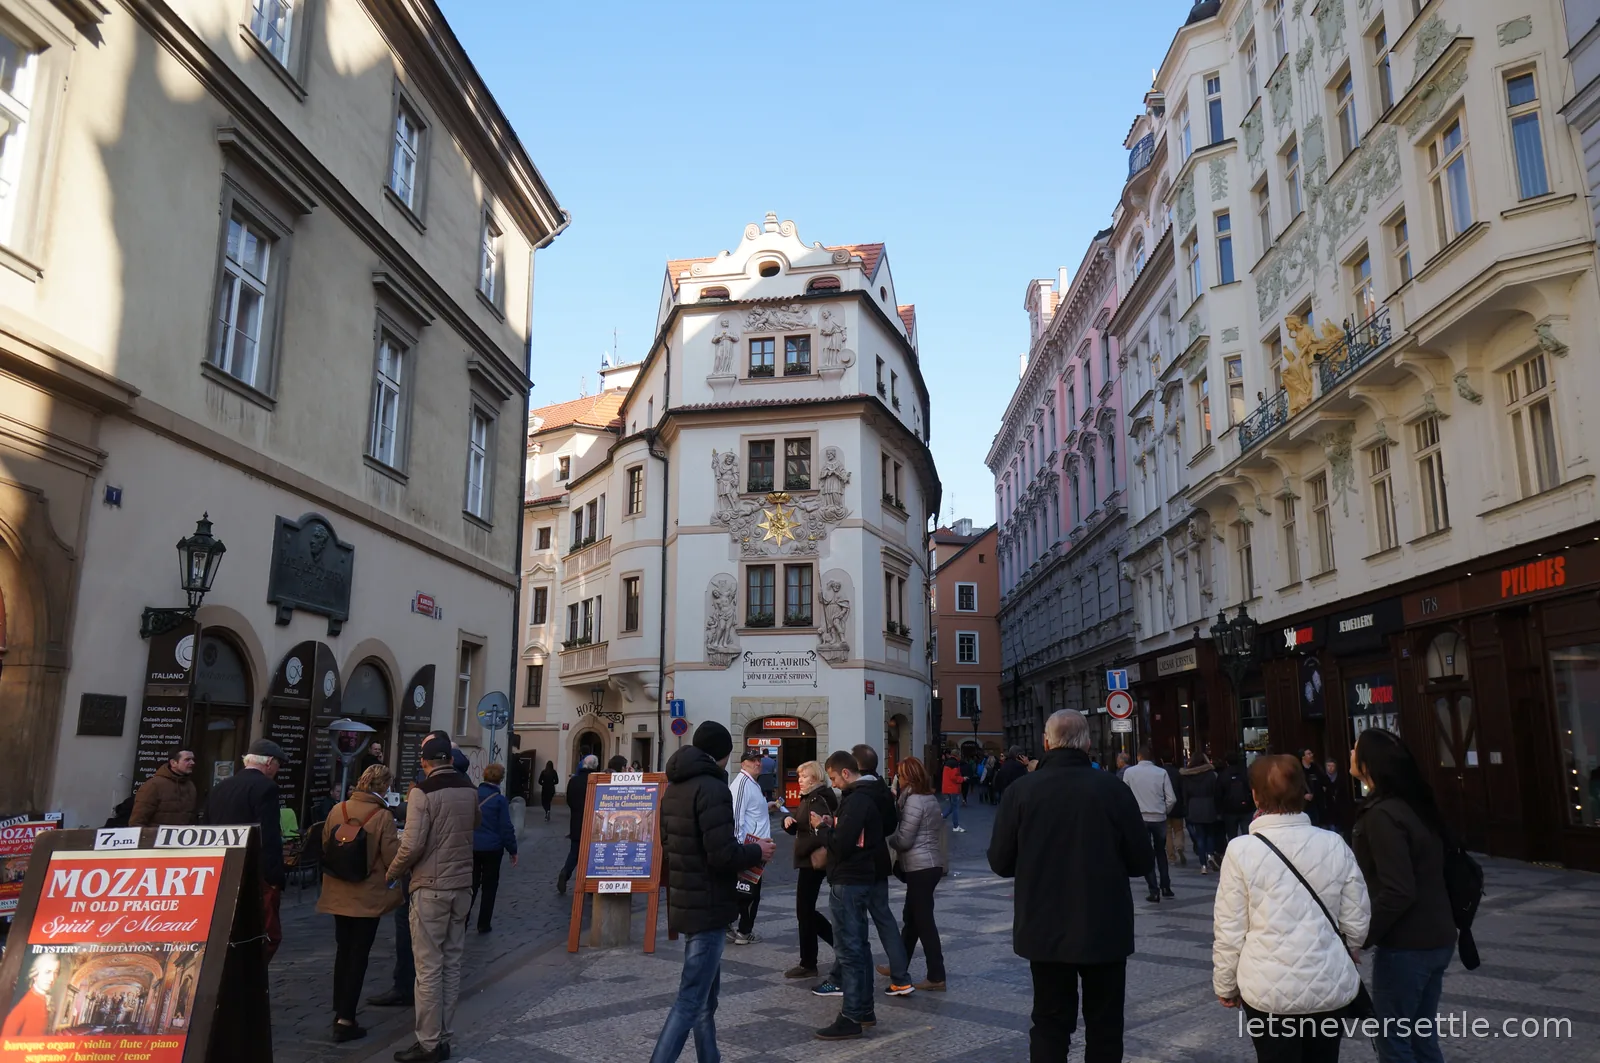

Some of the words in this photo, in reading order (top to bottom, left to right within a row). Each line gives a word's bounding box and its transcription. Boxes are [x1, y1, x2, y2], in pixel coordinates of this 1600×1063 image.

[1501, 556, 1566, 598] PYLONES
[1421, 597, 1438, 615] 178
[1339, 614, 1374, 633] JEWELLERY
[750, 658, 778, 667] HOTEL
[780, 658, 810, 666] AURUS
[151, 672, 184, 680] ITALIANO
[767, 672, 788, 680] ZLATÉ
[0, 815, 27, 827] ODAY
[100, 833, 115, 845] 7
[113, 838, 136, 847] p.m.
[160, 828, 247, 846] TODAY
[47, 867, 214, 898] MOZART
[70, 901, 85, 912] IN
[90, 901, 120, 912] OLD
[123, 900, 179, 911] PRAGUE
[42, 916, 94, 939] Spirit
[97, 916, 122, 937] of
[124, 915, 198, 932] Mozart
[32, 944, 80, 954] MYSTERY
[88, 944, 153, 953] MEDITATION
[163, 943, 200, 952] MAGIC
[4, 1040, 45, 1052] baroque
[47, 1042, 76, 1052] organ
[84, 1040, 111, 1049] violin
[119, 1040, 143, 1049] flute
[150, 1040, 179, 1050] piano
[25, 1053, 67, 1063] soprano
[74, 1052, 116, 1062] baritone
[124, 1053, 152, 1061] tenor
